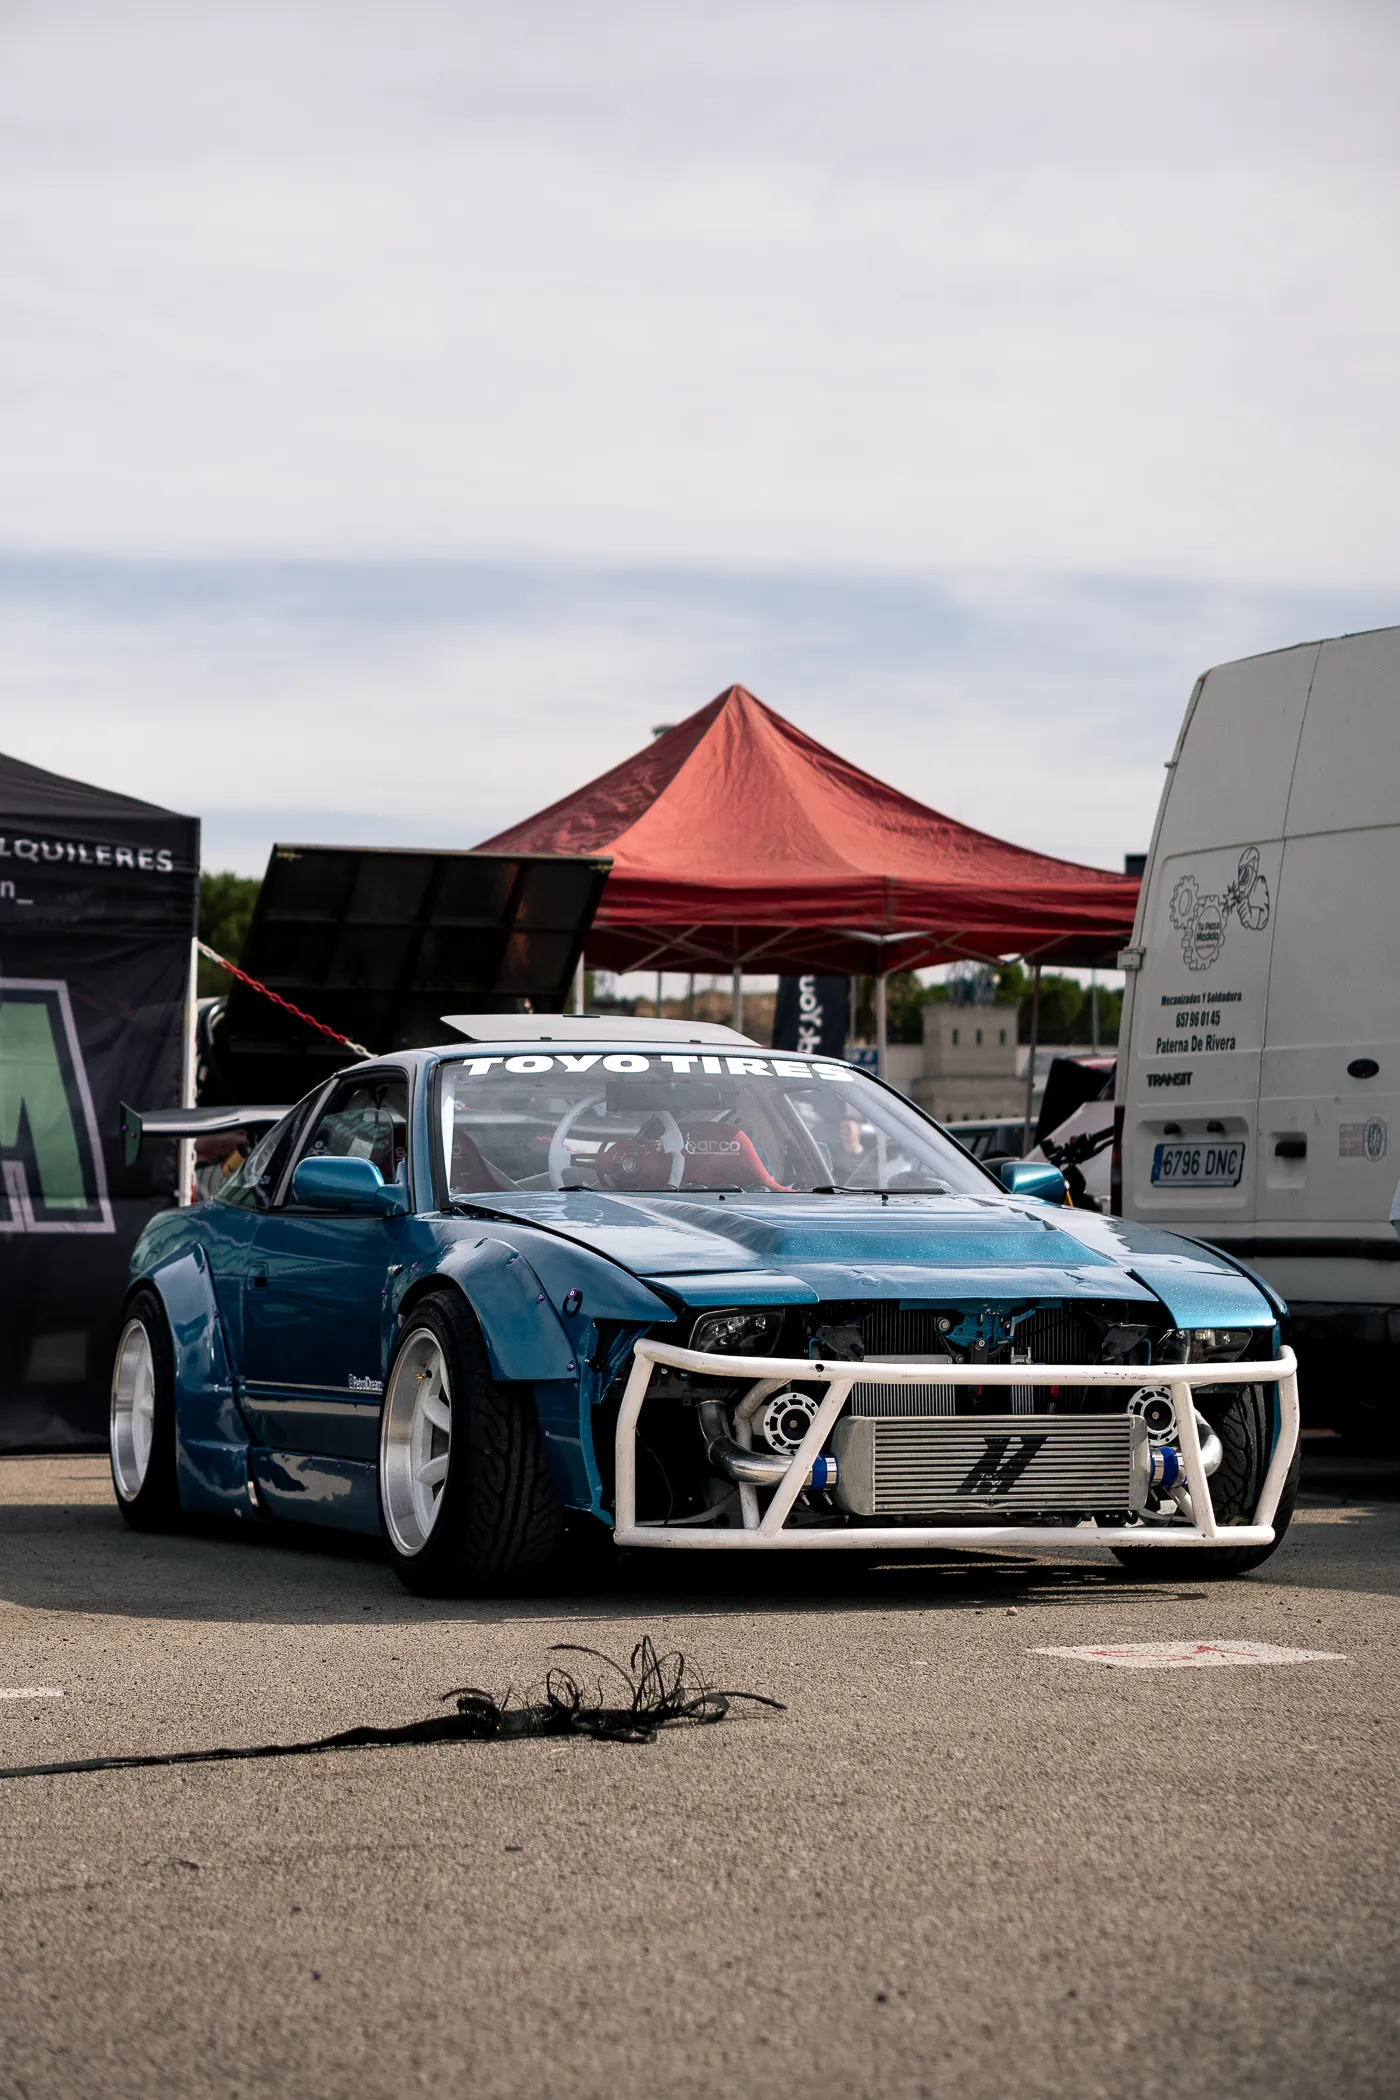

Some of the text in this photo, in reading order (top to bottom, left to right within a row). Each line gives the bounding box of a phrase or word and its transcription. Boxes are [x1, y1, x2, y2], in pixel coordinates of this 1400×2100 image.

[1161, 990, 1242, 1006] Mecanizados Y Soldadura
[1176, 1011, 1189, 1028] 657
[1189, 1010, 1200, 1028] 96
[1210, 1009, 1221, 1026] 45
[1156, 1033, 1236, 1054] Paterna De Rivera
[461, 1054, 854, 1082] TOYO TIRES
[1146, 1071, 1193, 1088] TRANSIT
[1163, 1149, 1238, 1176] 6796 DNC
